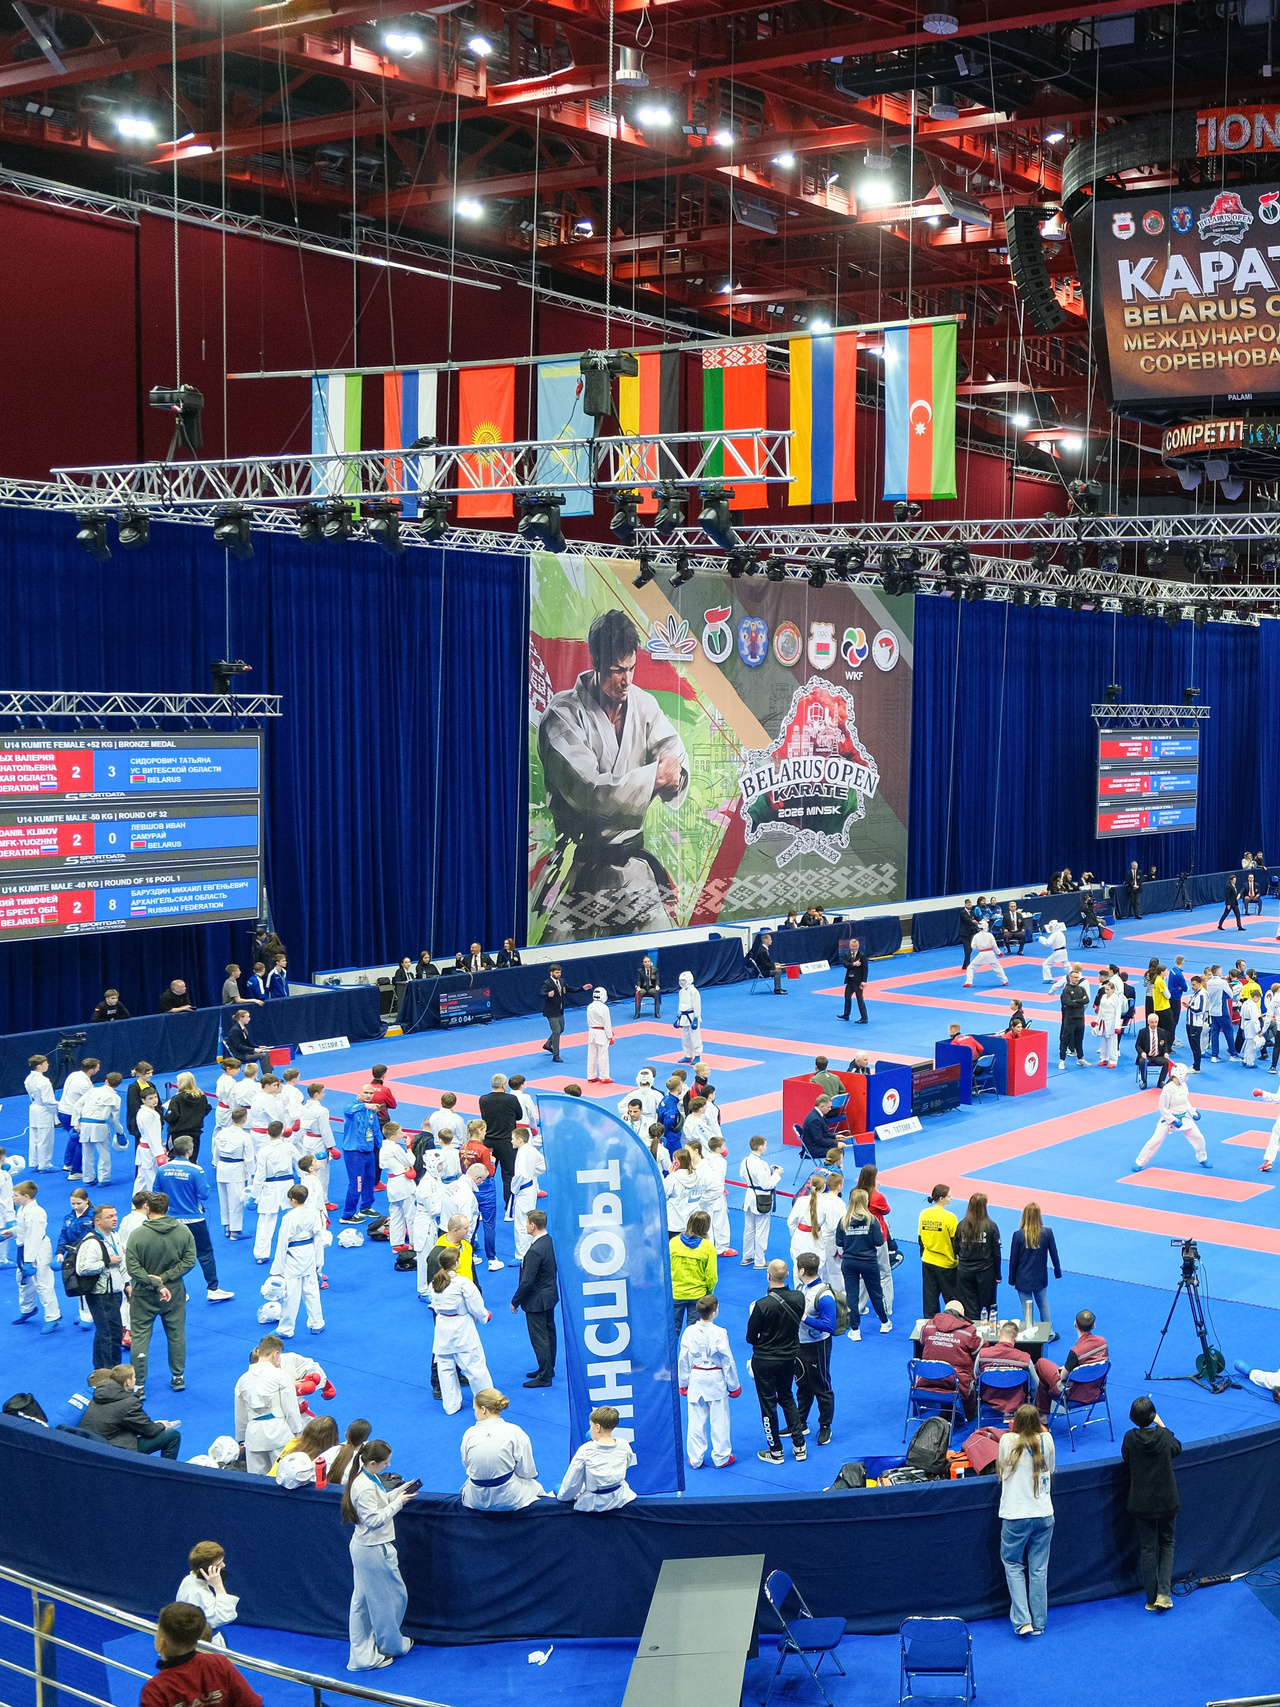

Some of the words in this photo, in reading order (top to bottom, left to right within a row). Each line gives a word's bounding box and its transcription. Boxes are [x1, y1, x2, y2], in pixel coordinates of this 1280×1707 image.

[1124, 297, 1257, 327] BELARUS
[845, 672, 863, 681] WKF
[151, 740, 176, 748] MEDAL
[72, 766, 81, 778] 2
[108, 766, 116, 777] 3
[142, 766, 186, 774] ВИТЕБСКОЙ
[742, 759, 823, 798] BELARUS
[828, 761, 877, 794] OPEN
[774, 784, 848, 801] KARATE
[778, 809, 804, 818] 2026
[807, 806, 841, 816] MINSK
[26, 828, 58, 836] KLIMOV
[131, 832, 167, 840] САМУРАЙ
[72, 834, 82, 846] 2
[108, 833, 116, 844] 0
[148, 841, 181, 849] BELARUS
[18, 884, 50, 893] KUMITE
[74, 881, 86, 889] -40
[104, 879, 132, 887] ROUND
[154, 875, 175, 883] POOL
[131, 888, 170, 897] БАРУЗДИН
[203, 882, 248, 891] ЕВГЕНЬЕВИЧ
[16, 895, 58, 905] ТИМОФЕЙ
[108, 899, 117, 911] 8
[131, 896, 193, 906] АРХАНГЕЛЬСКАЯ
[194, 893, 228, 902] ОБЛАСТЬ
[6, 908, 37, 916] БРЕСТ.
[38, 906, 58, 914] ОБЛ.
[73, 902, 82, 914] 2
[148, 906, 179, 914] RUSSIAN
[180, 902, 224, 911] FEDERATION
[1, 918, 39, 927] BELARUS
[763, 1416, 775, 1447] adidas
